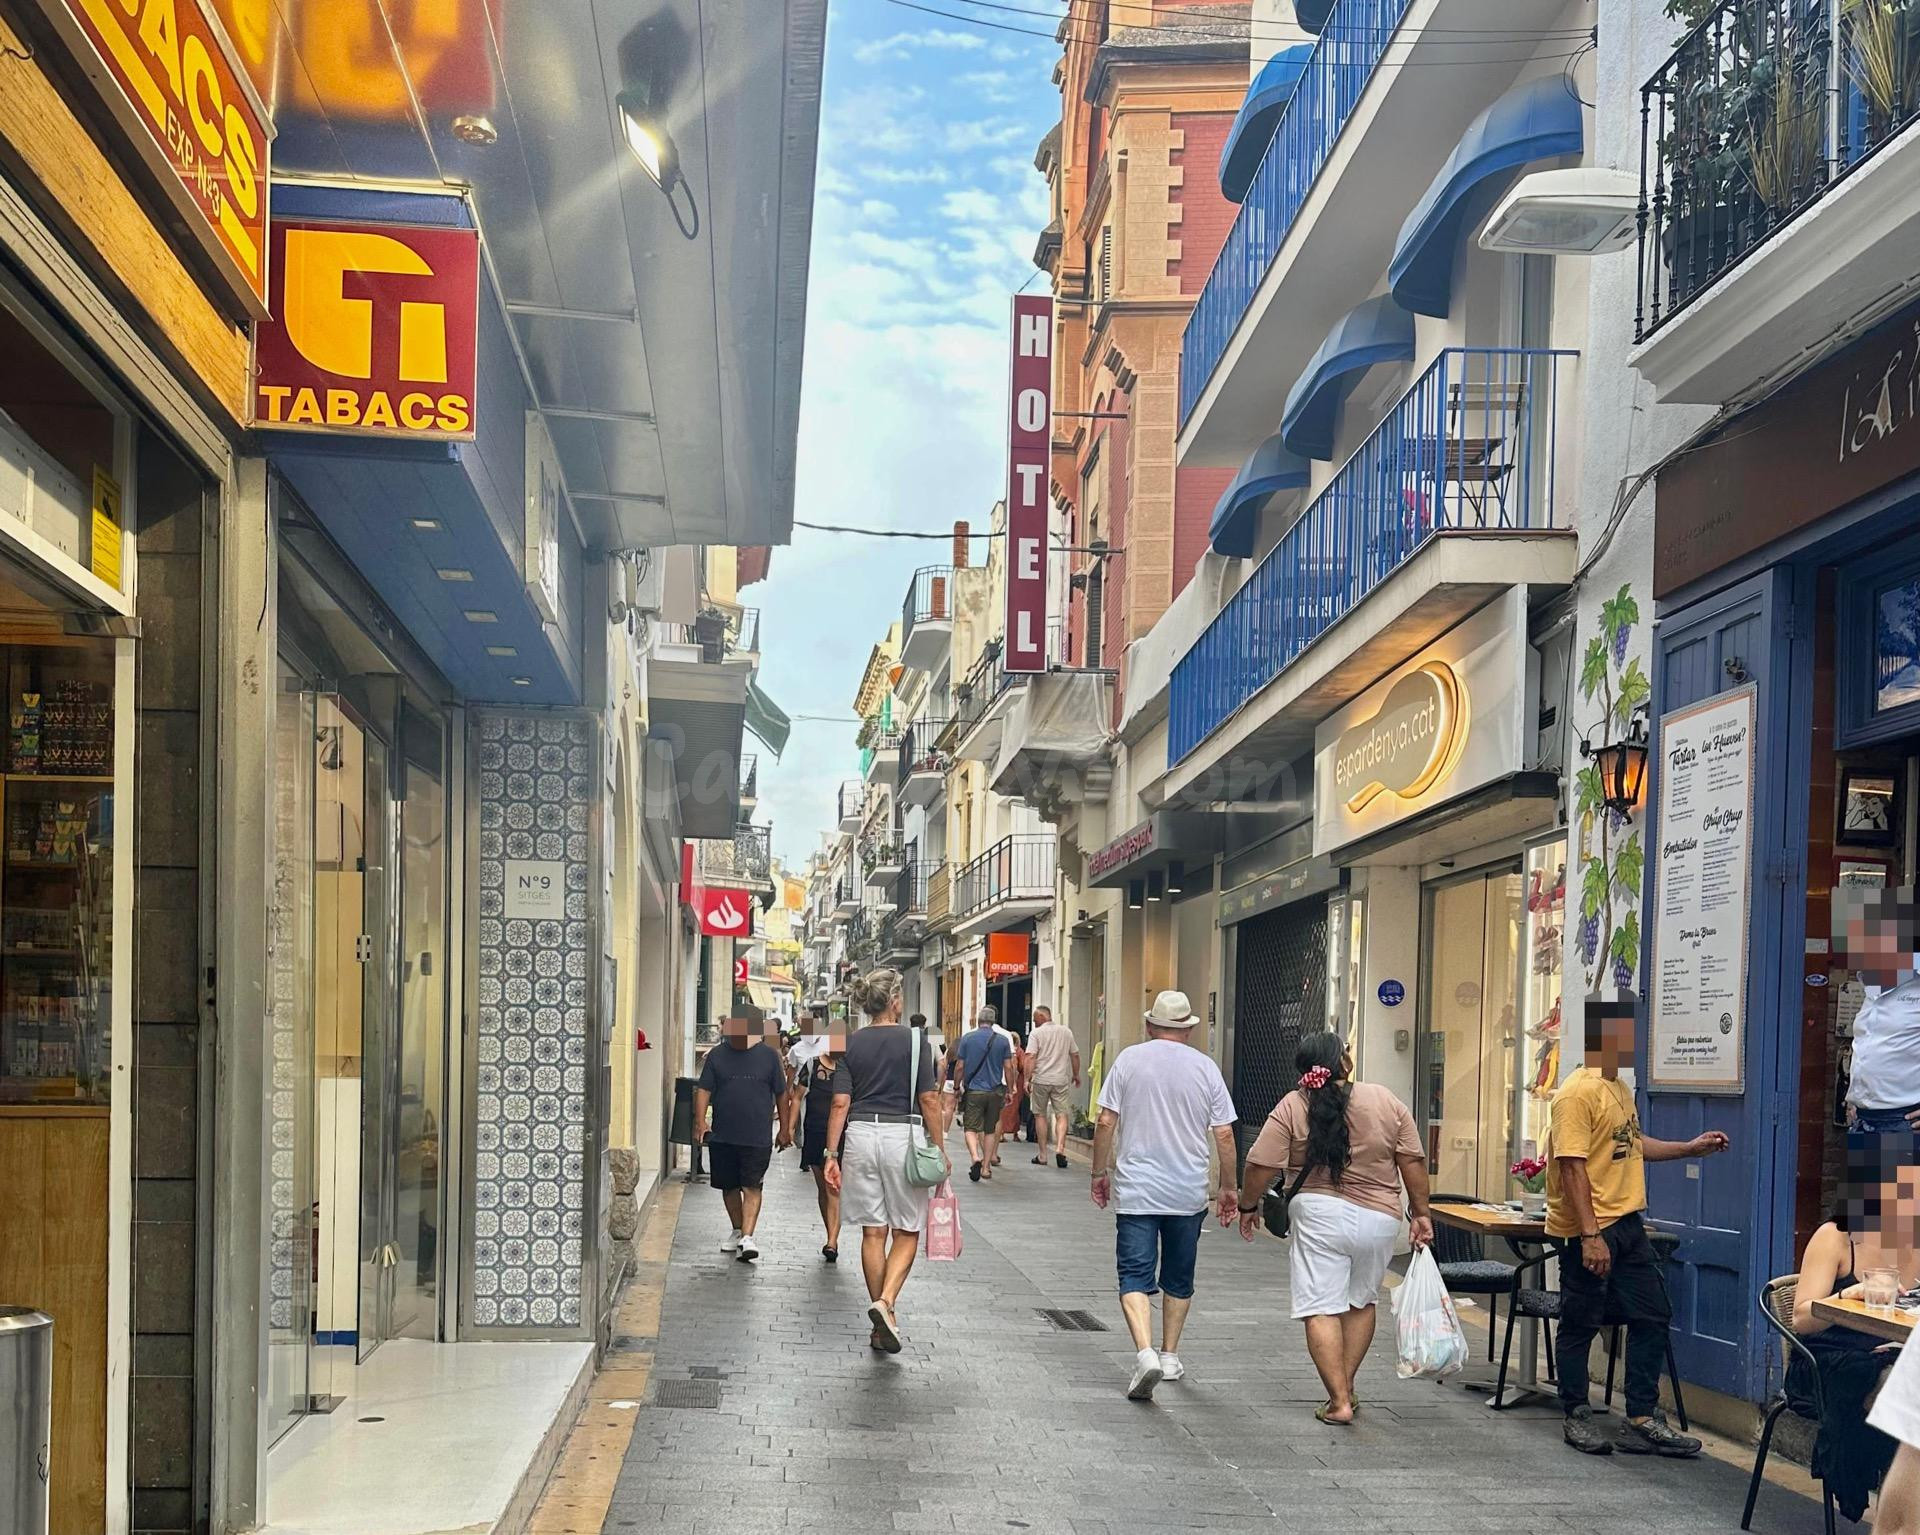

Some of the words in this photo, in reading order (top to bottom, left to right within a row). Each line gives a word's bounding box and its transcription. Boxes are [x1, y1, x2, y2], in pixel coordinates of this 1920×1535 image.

[259, 385, 469, 432] TABACS
[1016, 314, 1048, 652] HOTEL
[1336, 696, 1435, 786] espardenya.cat
[518, 891, 551, 900] SITGES
[991, 963, 1025, 974] orange
